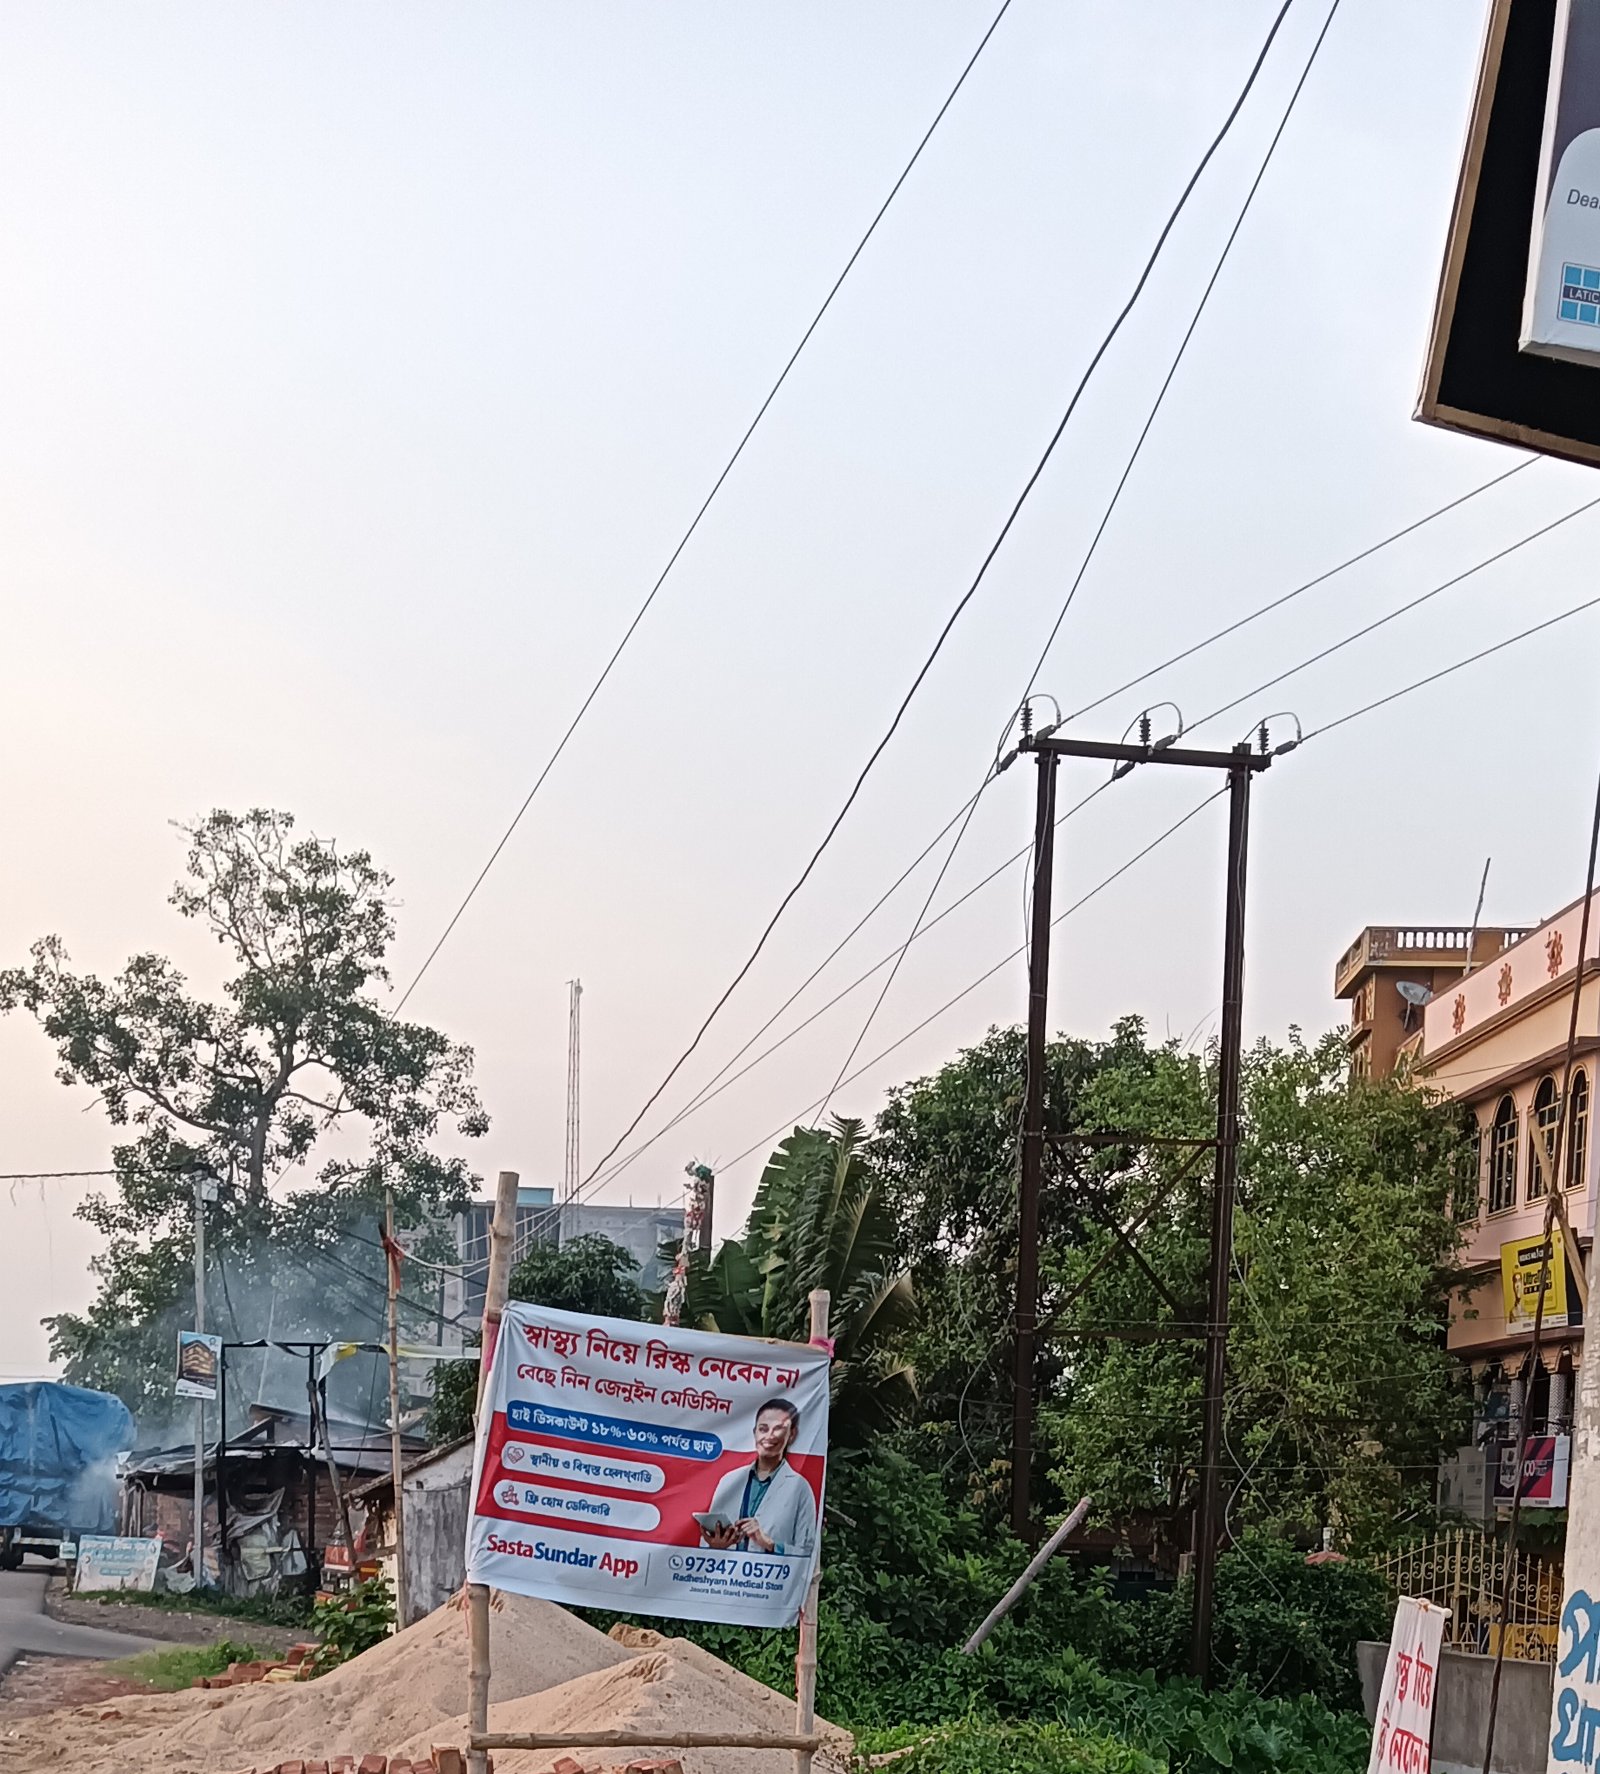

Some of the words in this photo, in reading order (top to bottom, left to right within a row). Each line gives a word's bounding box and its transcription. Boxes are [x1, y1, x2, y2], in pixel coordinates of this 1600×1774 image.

[1567, 188, 1600, 209] Dea
[522, 1323, 581, 1359] স্বাস্থ্য
[586, 1328, 641, 1364] নিয়ে
[645, 1339, 694, 1375] রিস্ক
[698, 1356, 771, 1387] নেবেন
[776, 1367, 800, 1389] না
[517, 1363, 557, 1388] বেছে
[560, 1365, 591, 1391] নিন
[594, 1377, 657, 1404] জেনুইন
[661, 1387, 733, 1415] মেডিসিন
[512, 1407, 530, 1424] হাই
[533, 1409, 589, 1431] ডিসকাউন্ট
[661, 1434, 691, 1451] পর্যন্ত
[693, 1440, 717, 1455] ছাড়
[530, 1452, 559, 1468] স্থানীয়
[562, 1459, 571, 1470] ও
[525, 1490, 539, 1504] ফ্রি
[541, 1494, 564, 1509] হোম
[565, 1498, 611, 1516] ডেলিভারি
[486, 1534, 598, 1568] SastaSundar
[599, 1552, 639, 1578] App
[685, 1556, 737, 1575] 97347
[742, 1561, 790, 1580] 05779
[672, 1573, 727, 1586] Radheshyam
[729, 1578, 764, 1590] Medical
